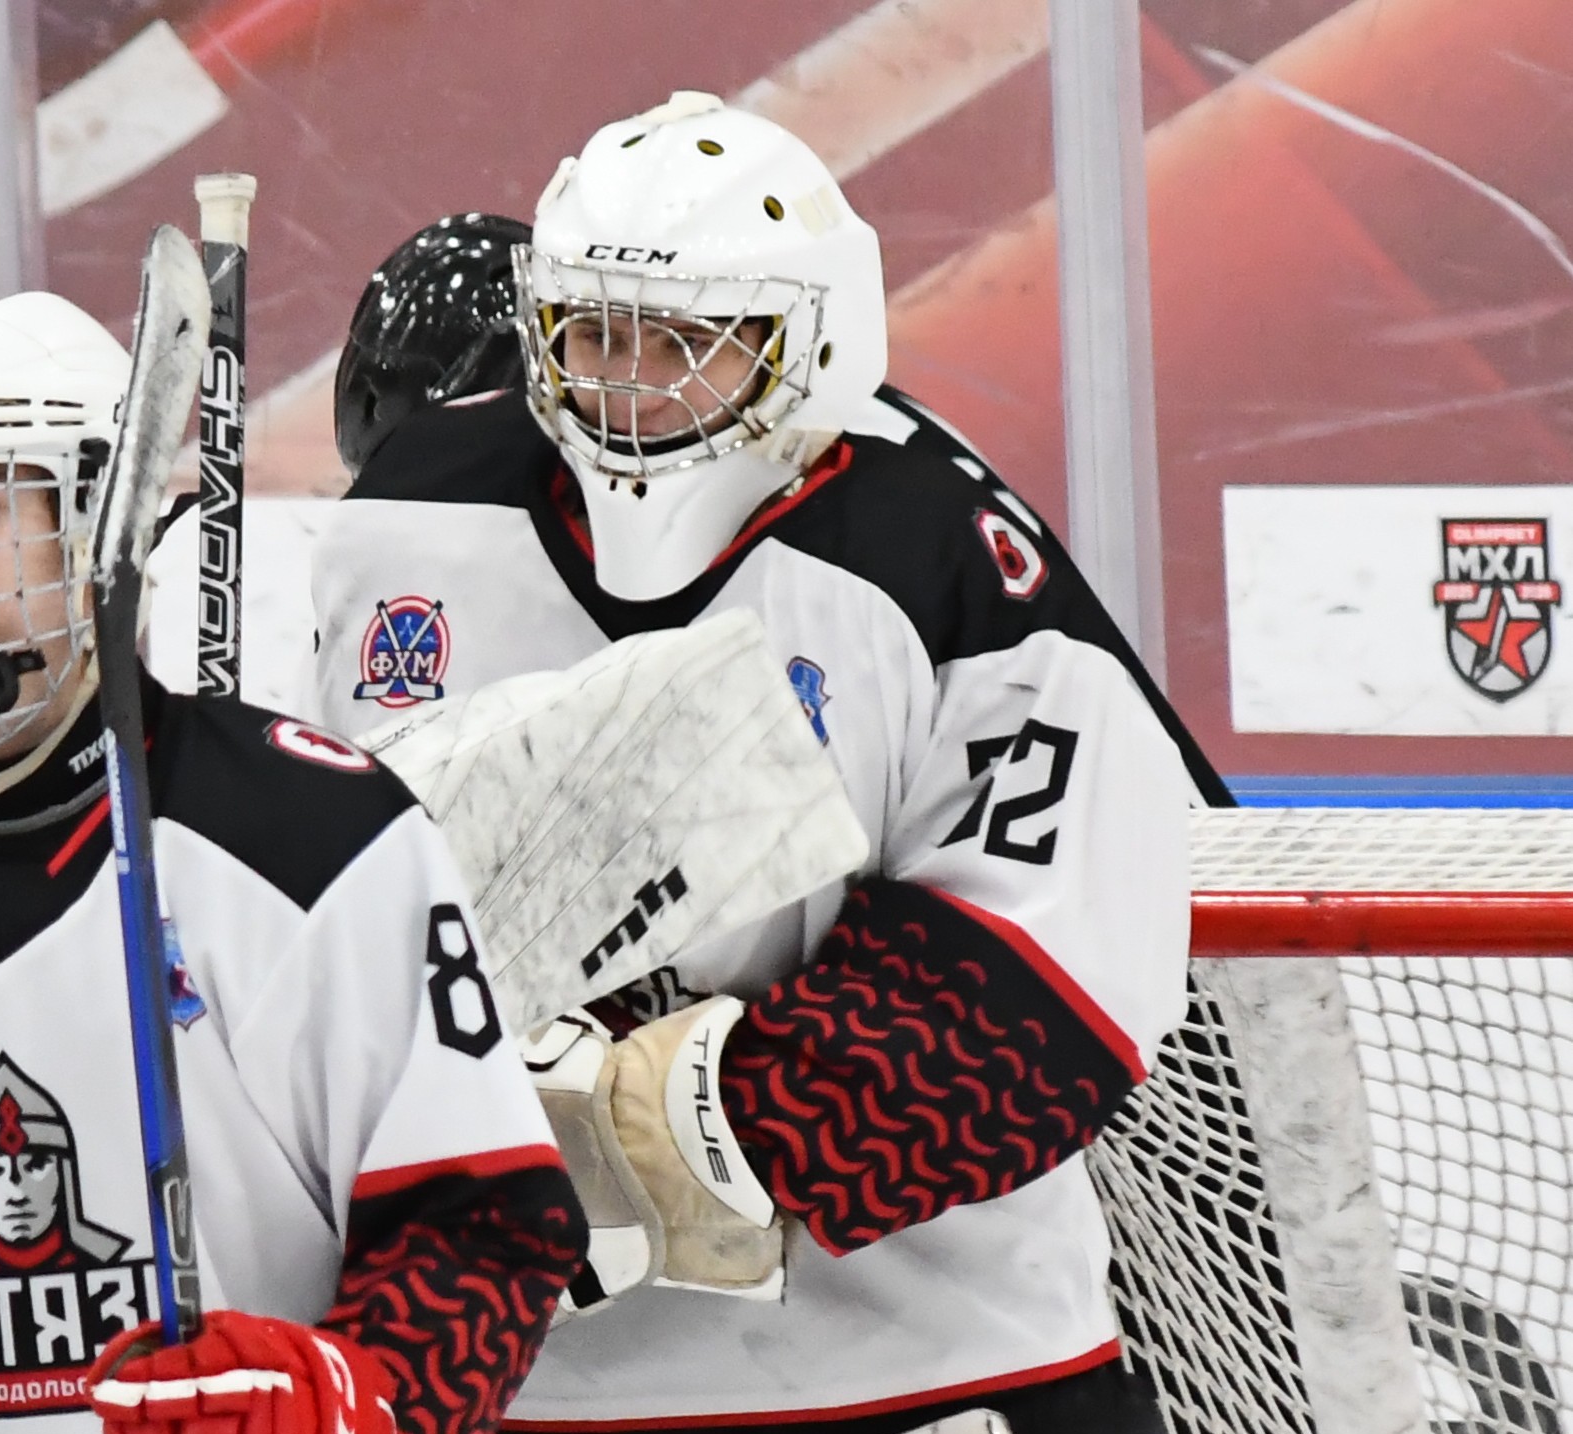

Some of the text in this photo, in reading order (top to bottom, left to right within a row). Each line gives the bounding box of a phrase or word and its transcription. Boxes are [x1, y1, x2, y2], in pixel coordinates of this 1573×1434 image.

[585, 244, 678, 265] CCM
[1446, 546, 1547, 581] МХЛ
[370, 651, 436, 678] ФХМ
[425, 902, 502, 1060] 8
[692, 1028, 732, 1184] TRUE
